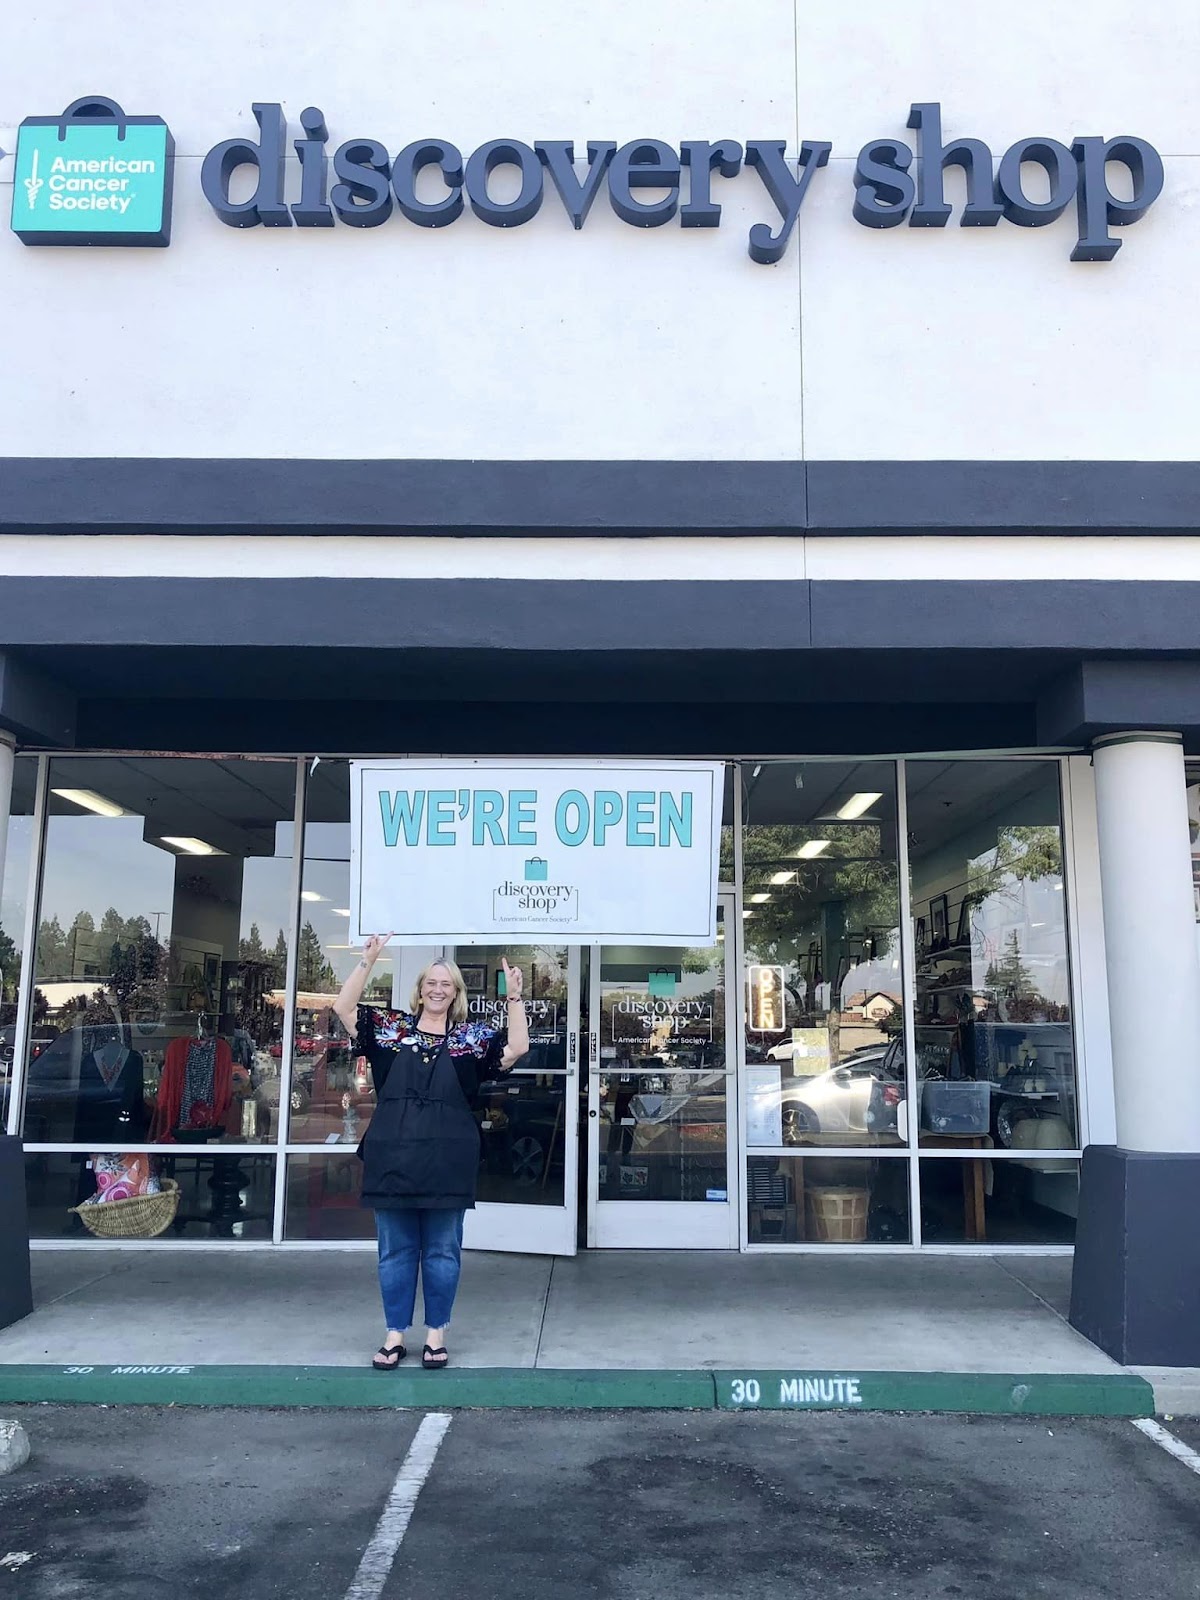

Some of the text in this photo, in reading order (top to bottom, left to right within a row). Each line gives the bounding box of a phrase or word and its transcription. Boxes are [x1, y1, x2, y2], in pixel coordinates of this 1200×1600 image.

[50, 156, 155, 173] American
[49, 175, 129, 191] Cancer
[201, 102, 1164, 265] discovery shop
[49, 193, 131, 214] Society
[554, 789, 693, 848] OPEN
[498, 881, 573, 901] discovery
[518, 893, 557, 914] shop
[618, 995, 706, 1020] discovery
[759, 968, 775, 1028] OPEN
[642, 1009, 687, 1035] shop
[529, 1036, 551, 1046] ociety
[680, 1037, 707, 1045] Society
[63, 1366, 195, 1374] 30 MINUTE
[731, 1378, 862, 1403] 30 MINUTE
